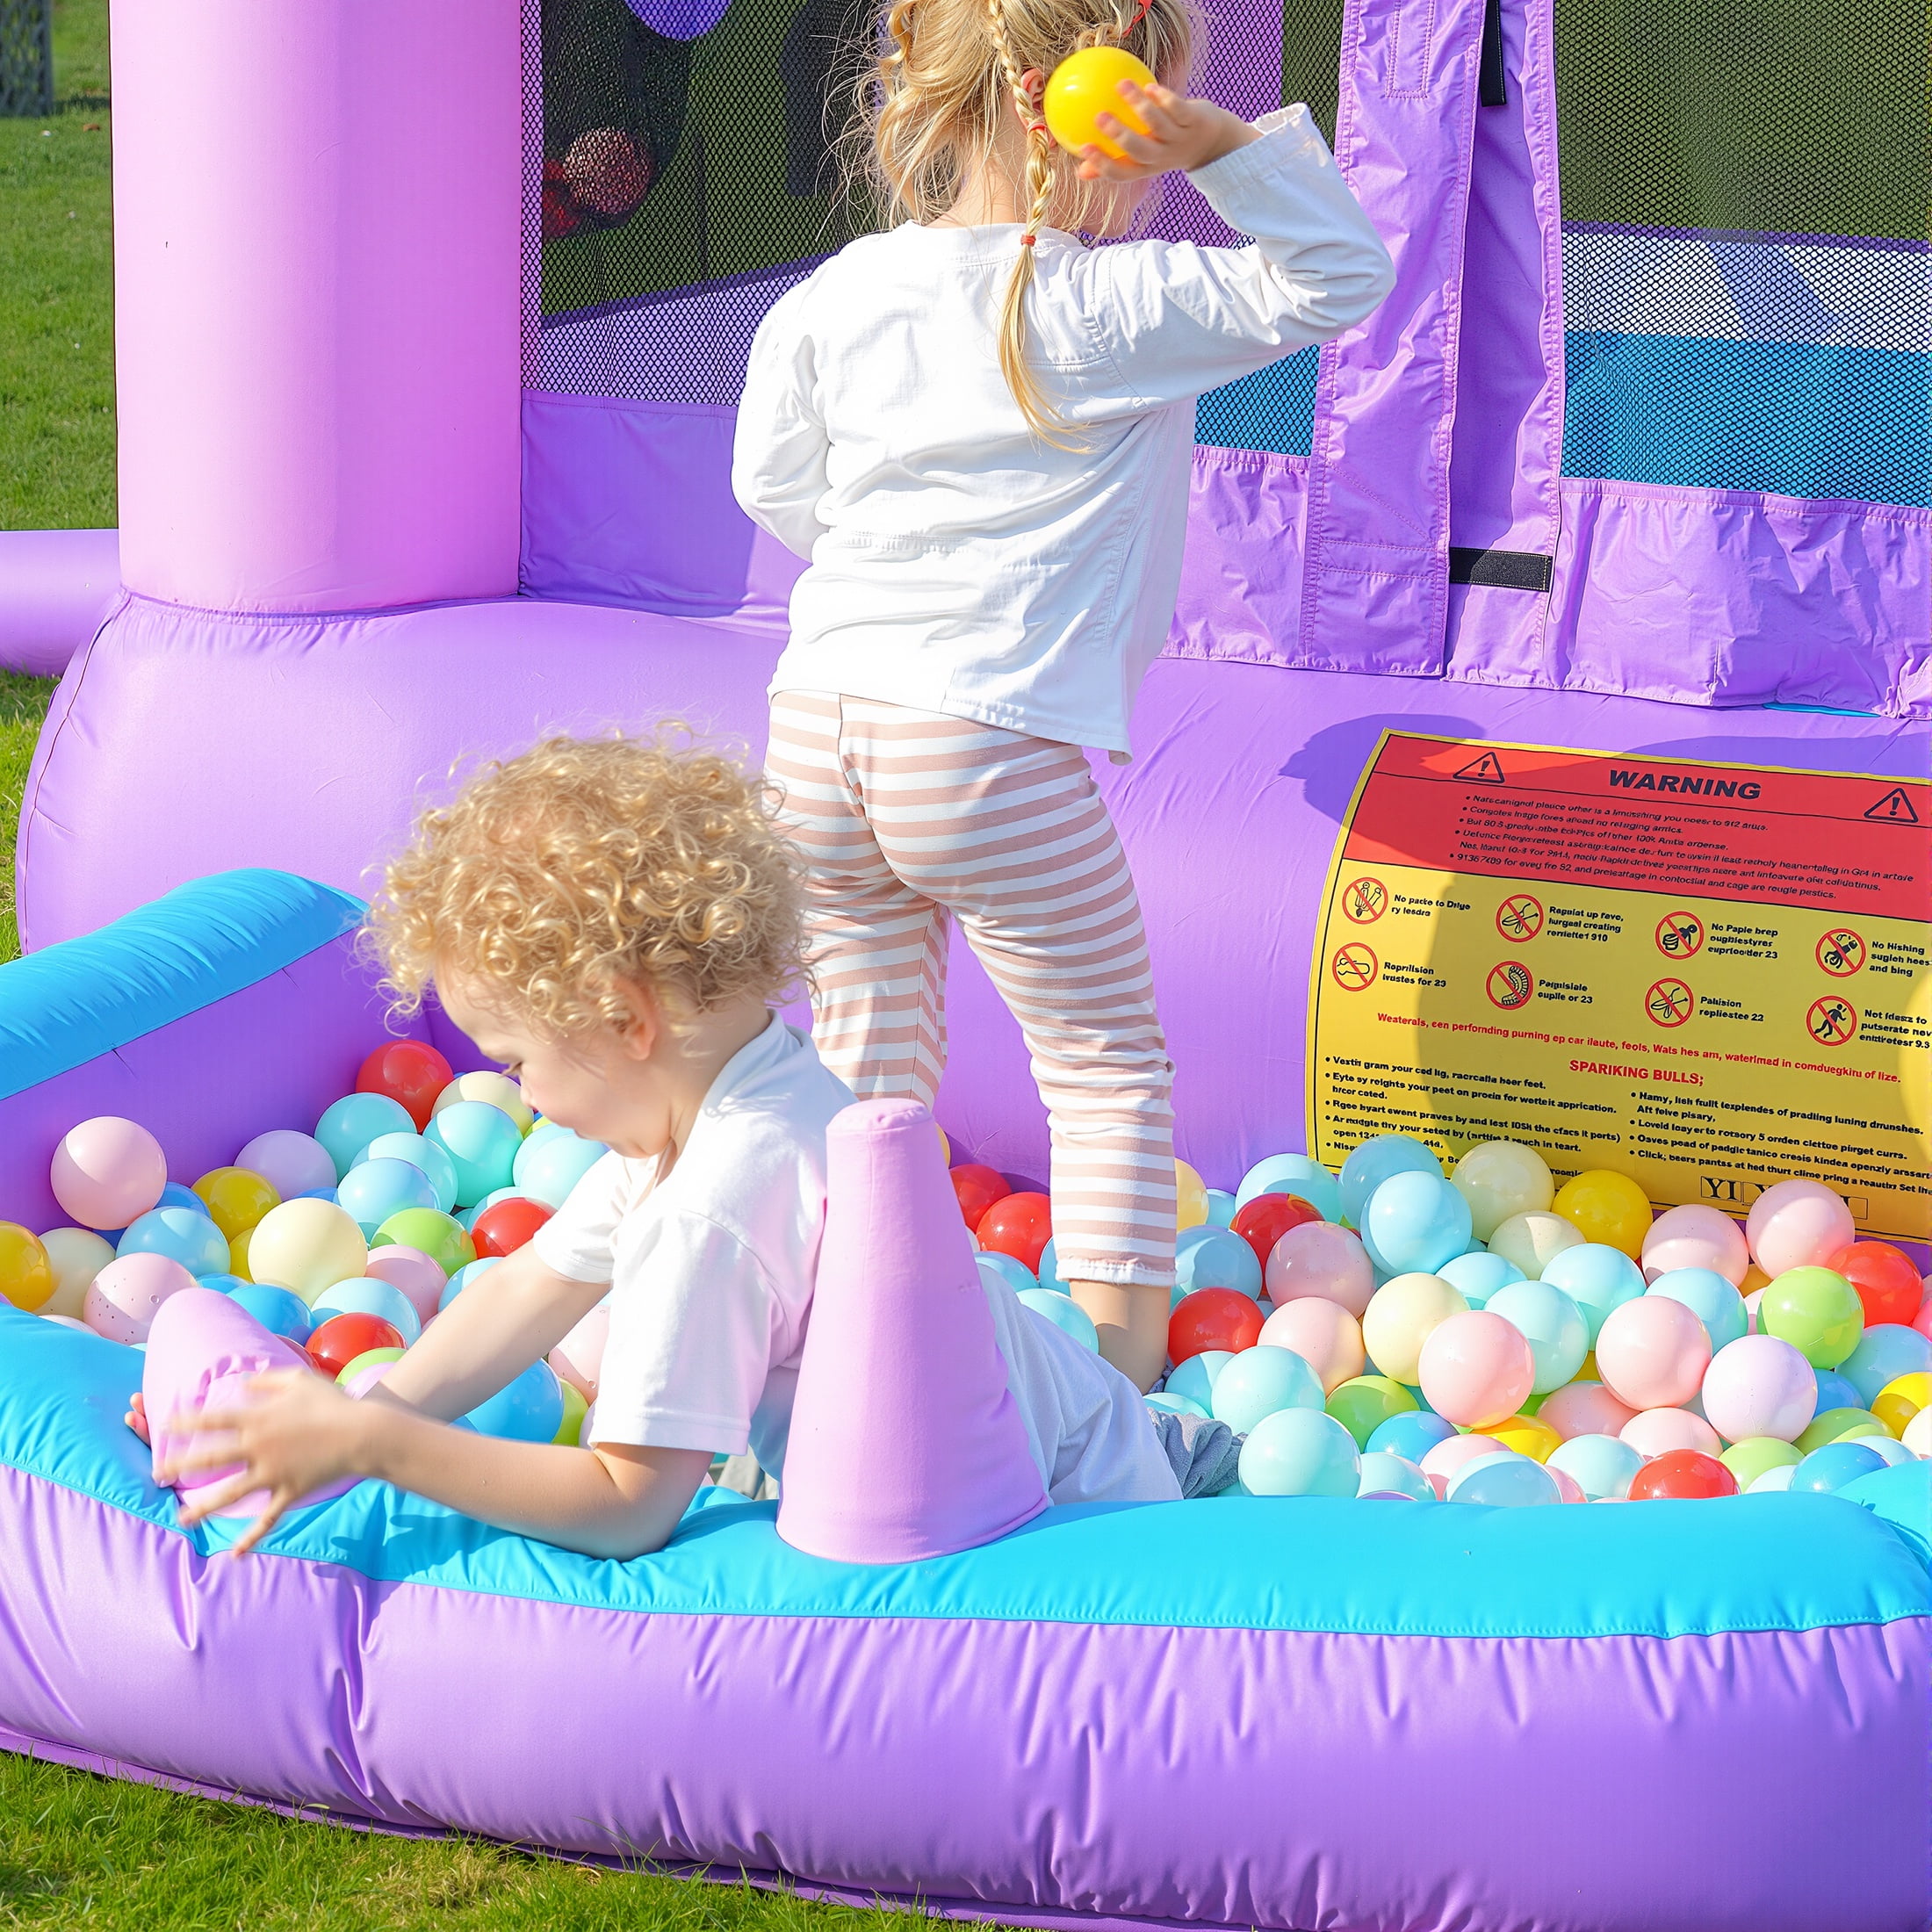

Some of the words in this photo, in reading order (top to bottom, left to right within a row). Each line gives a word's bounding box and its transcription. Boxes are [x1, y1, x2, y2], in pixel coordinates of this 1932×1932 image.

[1610, 769, 1761, 799] WARNING
[1394, 894, 1406, 903] No
[1586, 911, 1598, 919] up
[1711, 922, 1724, 931] No
[1871, 941, 1885, 949] No
[1764, 950, 1777, 959] 23
[1869, 964, 1888, 973] and
[1417, 977, 1432, 986] for
[1580, 995, 1592, 1004] 23
[1864, 1009, 1883, 1019] Not
[1680, 1046, 1699, 1056] hes
[1781, 1058, 1791, 1068] in
[1864, 1070, 1876, 1078] of
[1390, 1064, 1413, 1073] your
[1568, 1059, 1648, 1079] SPARIKING
[1652, 1069, 1704, 1086] BULLS;
[1407, 1083, 1431, 1092] your
[1503, 1092, 1518, 1102] for
[1455, 1114, 1467, 1125] by
[1468, 1117, 1487, 1126] and
[1533, 1123, 1551, 1133] the
[1452, 1128, 1464, 1139] by
[1757, 1132, 1765, 1141] 5
